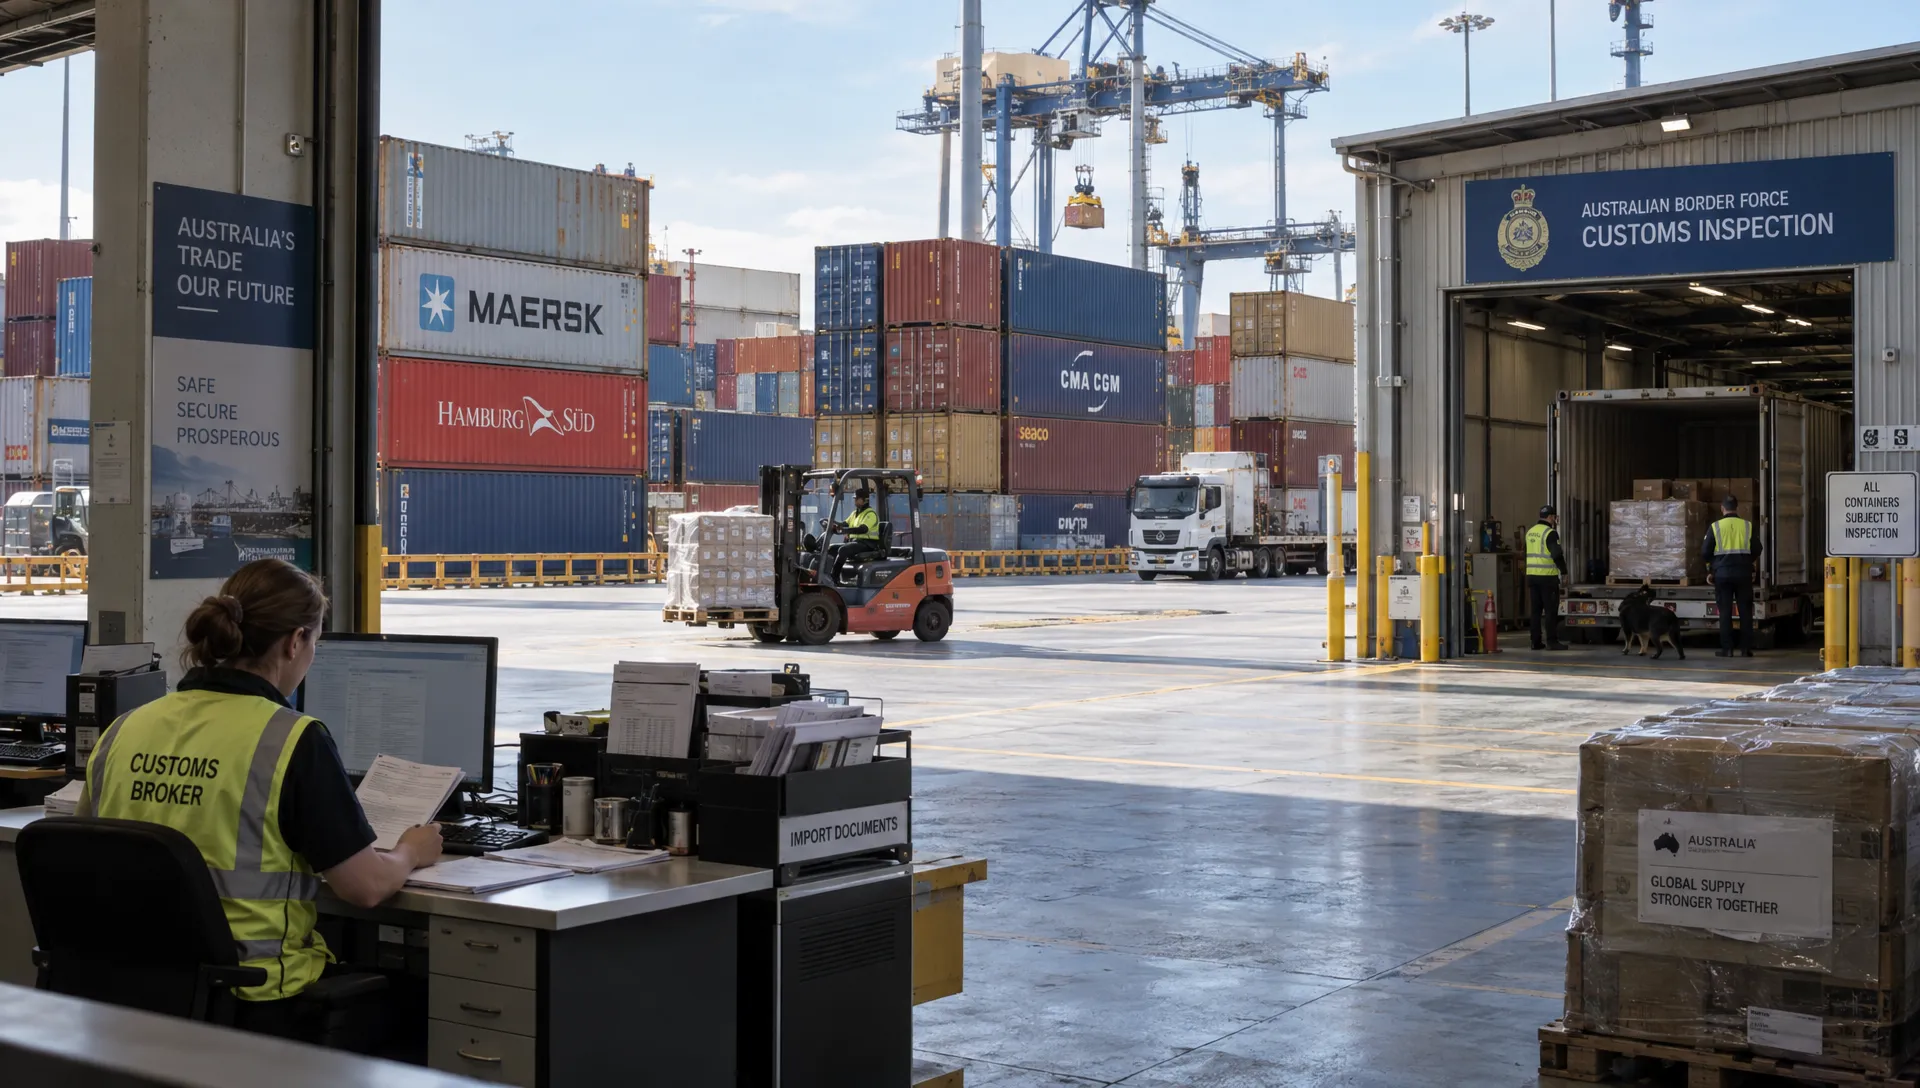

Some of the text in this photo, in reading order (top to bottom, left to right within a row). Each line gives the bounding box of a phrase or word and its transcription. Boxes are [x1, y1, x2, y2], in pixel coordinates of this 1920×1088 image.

[1581, 189, 1790, 218] AUSTRALIAN BORDER FORCE
[177, 216, 296, 251] AUSTRALIA'S
[1581, 211, 1834, 249] CUSTOMS INSPECTION
[177, 244, 243, 272] TRADE
[177, 274, 295, 306] OUR FUTURE
[468, 289, 604, 336] MAERSK
[177, 375, 216, 394] SAFE
[1060, 369, 1120, 394] CMA CGM
[177, 401, 238, 421] SECURE
[562, 407, 596, 433] SÜD
[177, 427, 280, 447] PROSPEROUS
[1019, 426, 1049, 441] seaco
[1863, 481, 1881, 493] ALL
[1844, 496, 1900, 508] CONTAINERS
[1845, 512, 1899, 523] SUBJECT TO
[1845, 527, 1899, 539] INSPECTION
[130, 752, 220, 779] CUSTOMS
[130, 780, 204, 806] BROKER
[790, 816, 898, 848] IMPORT DOCUMENTS
[1688, 835, 1757, 850] AUSTRALIA
[1650, 874, 1746, 895] GLOBAL SUPPLY
[1650, 892, 1779, 915] STRONGER TOGETHER
